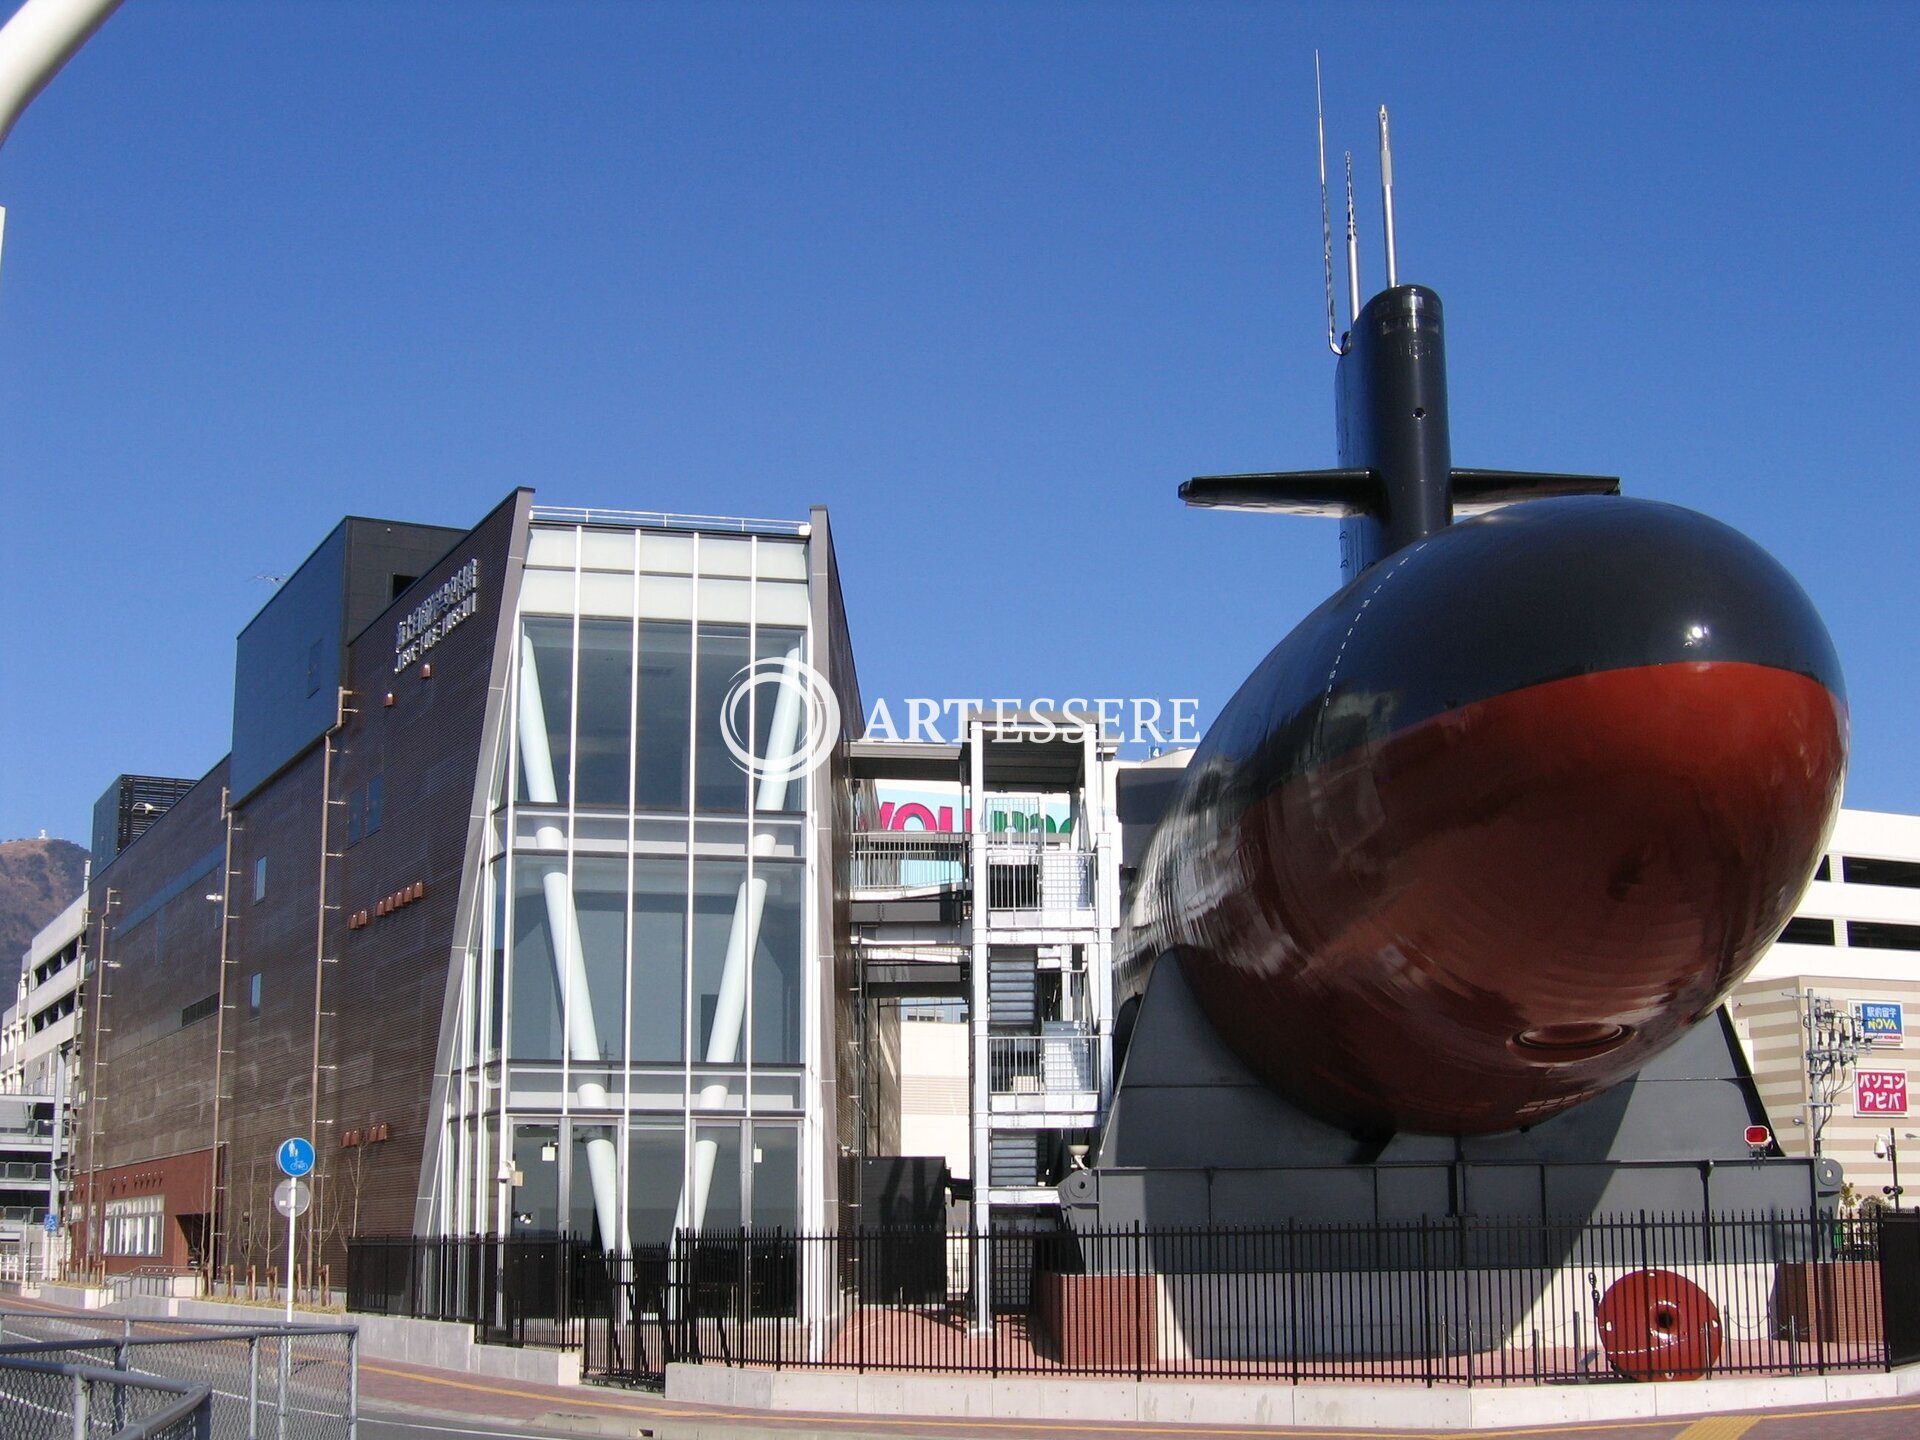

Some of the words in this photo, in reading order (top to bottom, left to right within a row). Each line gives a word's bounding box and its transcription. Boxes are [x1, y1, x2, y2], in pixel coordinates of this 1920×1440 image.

[1867, 1018, 1897, 1030] NOVA
[1859, 1074, 1904, 1090] パソコン
[1863, 1091, 1901, 1110] アビバ
